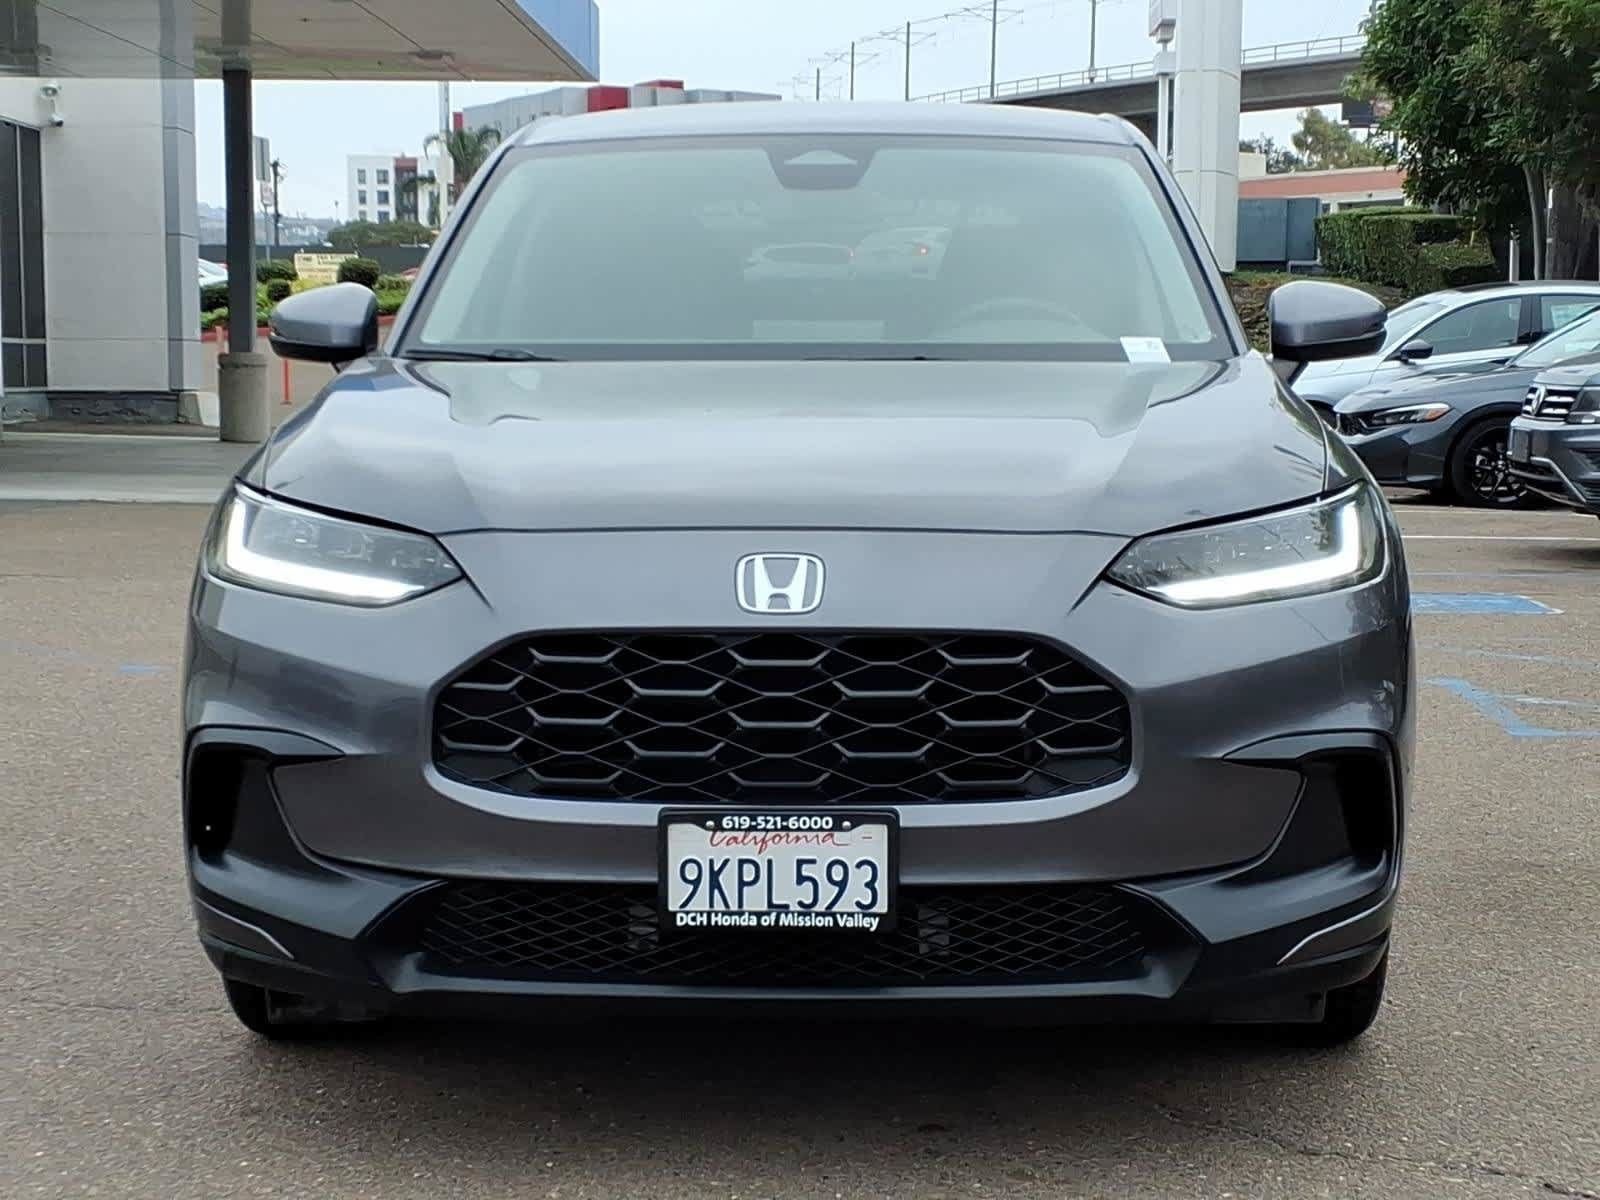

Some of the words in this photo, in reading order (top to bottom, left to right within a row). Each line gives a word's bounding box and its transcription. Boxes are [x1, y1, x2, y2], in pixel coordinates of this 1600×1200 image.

[721, 816, 833, 830] 619-521-6000
[708, 830, 849, 855] California
[679, 858, 879, 911] 9KPL593
[675, 912, 708, 927] DCH
[710, 912, 758, 927] Honda
[760, 912, 776, 927] of
[779, 913, 834, 927] Mission
[836, 913, 879, 932] Valley
